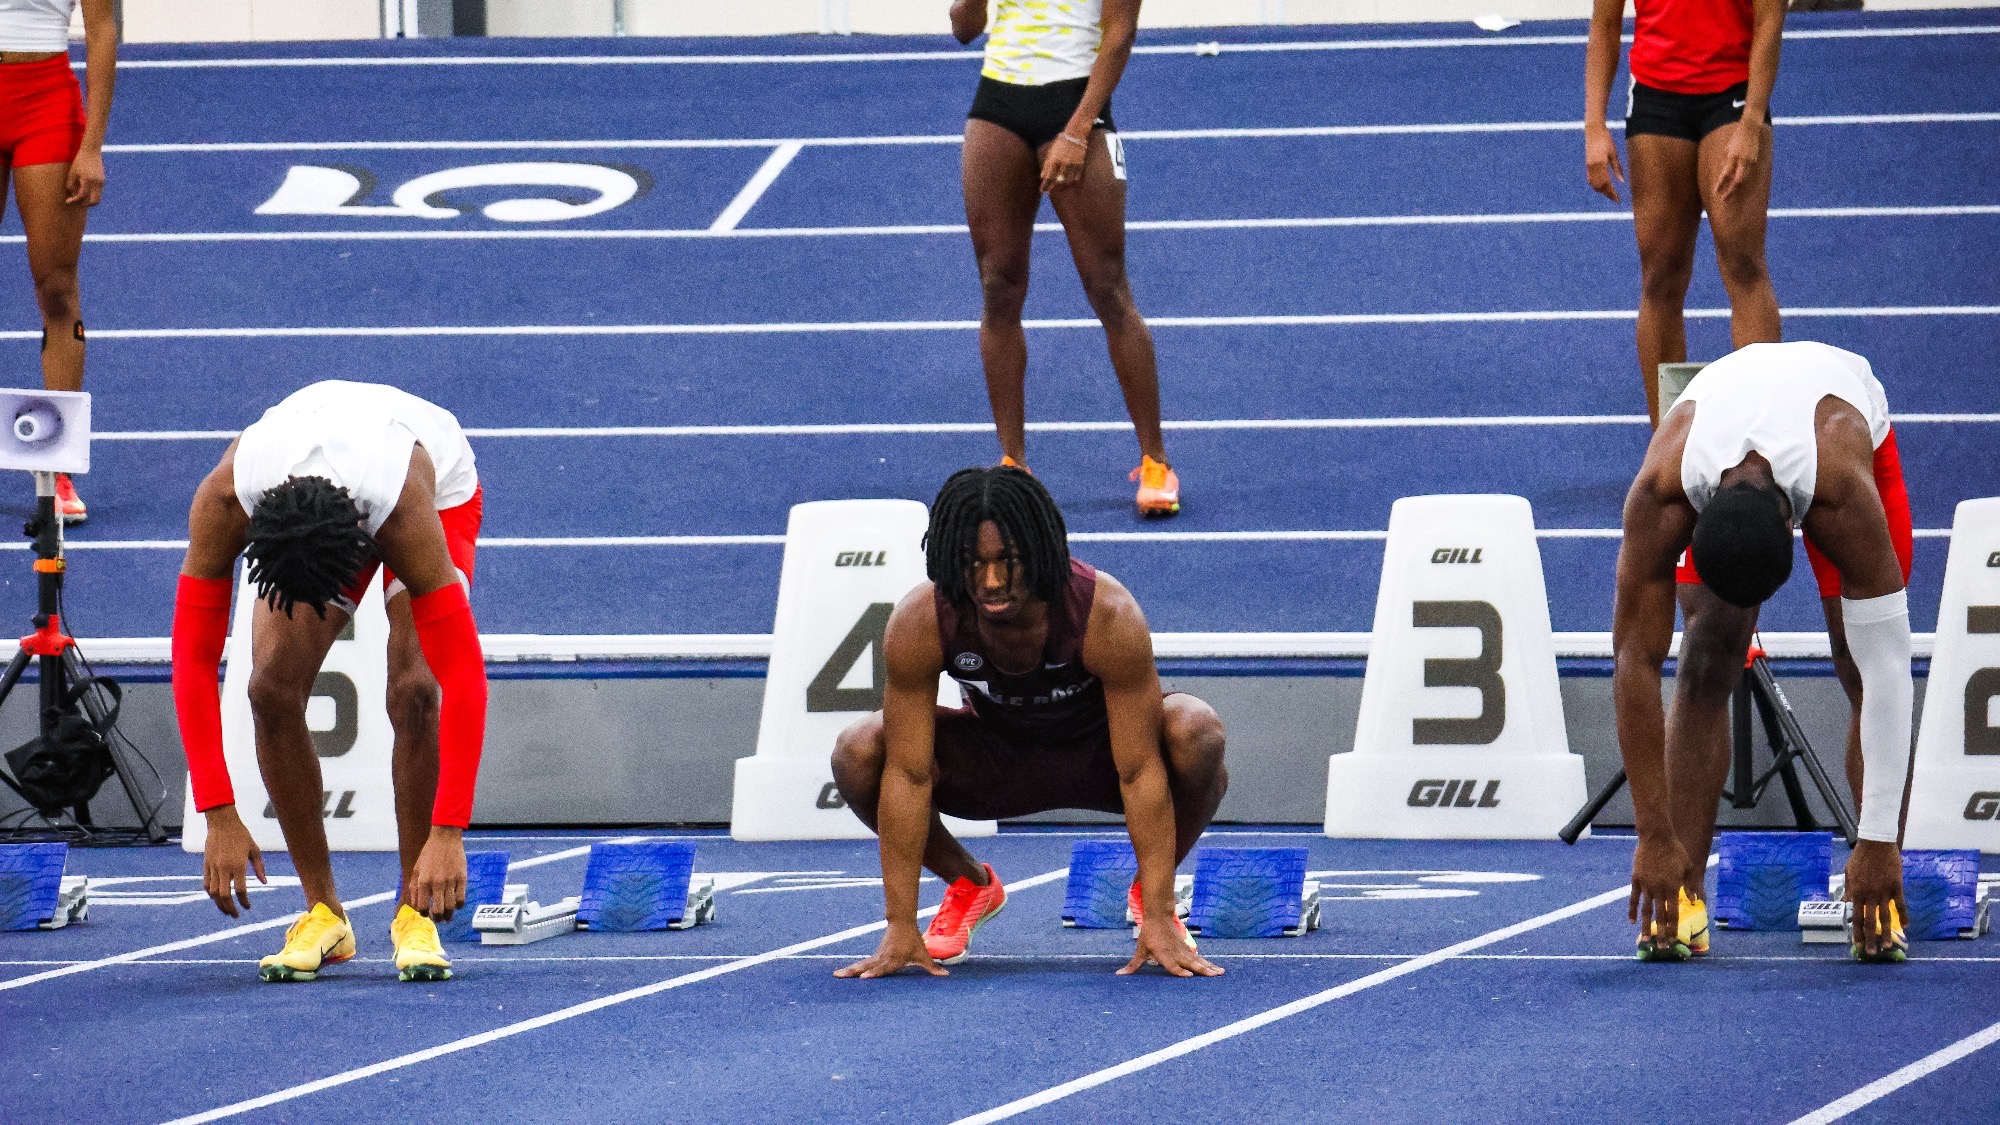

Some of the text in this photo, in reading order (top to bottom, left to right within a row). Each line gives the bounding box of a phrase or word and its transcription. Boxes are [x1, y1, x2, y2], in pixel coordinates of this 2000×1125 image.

[835, 551, 887, 567] GILL
[1431, 548, 1483, 564] GILL
[806, 602, 895, 712] 4
[1412, 600, 1506, 745] 3
[1406, 779, 1501, 807] GILL
[479, 906, 515, 914] GILL
